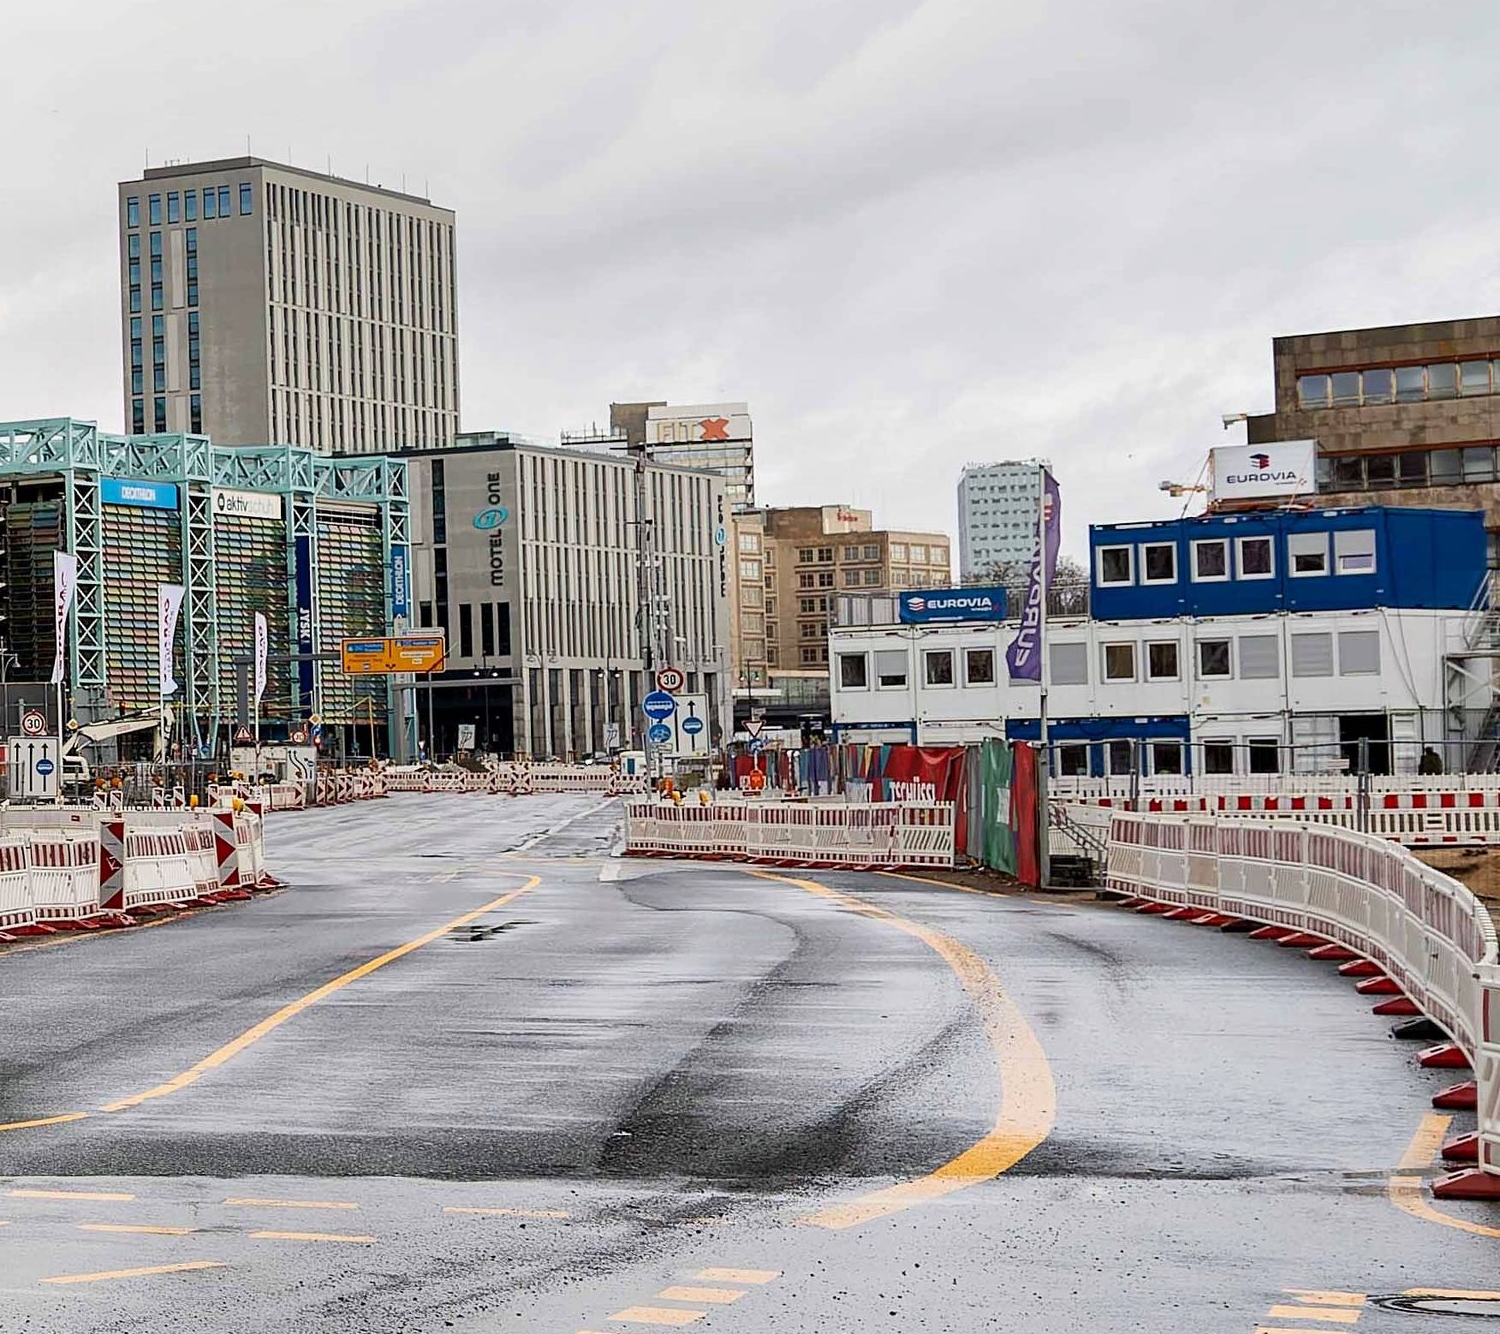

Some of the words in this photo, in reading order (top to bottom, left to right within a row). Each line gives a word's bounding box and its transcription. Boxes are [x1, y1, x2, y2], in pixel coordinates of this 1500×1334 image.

[1226, 471, 1297, 484] EUROVIA
[926, 597, 993, 609] EUROVIA
[663, 674, 677, 686] 30
[27, 718, 41, 730] 30
